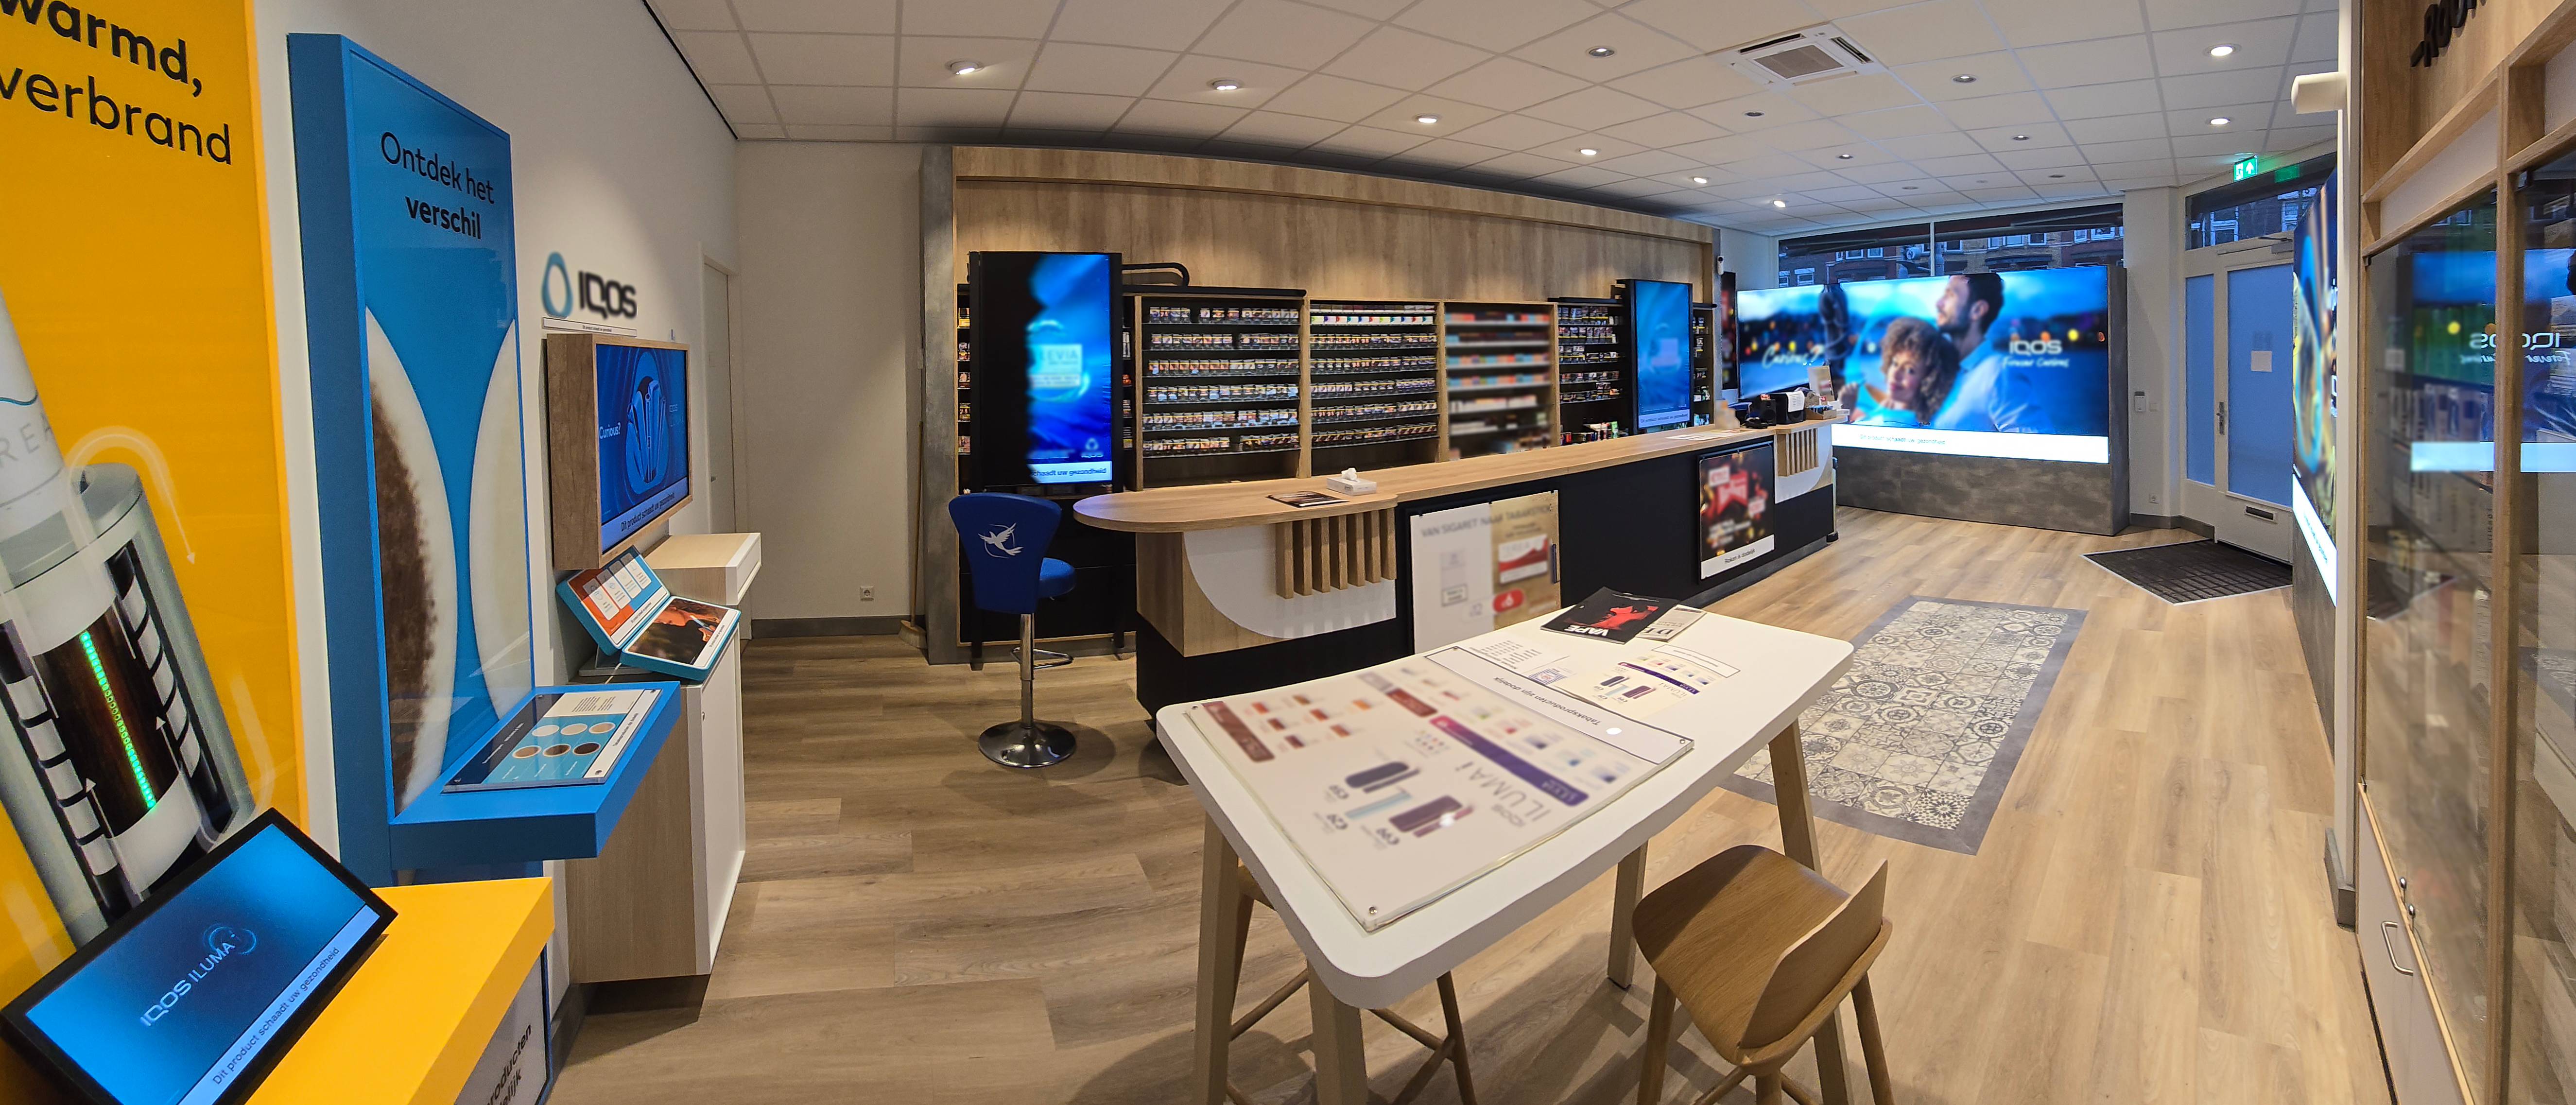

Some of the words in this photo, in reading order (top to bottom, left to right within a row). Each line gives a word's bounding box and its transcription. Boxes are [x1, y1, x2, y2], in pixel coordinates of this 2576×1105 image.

[0, 68, 231, 165] verbrand
[381, 132, 462, 192] Ontdek
[466, 167, 495, 205] het
[405, 195, 482, 240] verschil
[578, 271, 637, 319] IQOS
[2009, 340, 2063, 357] IQOS
[599, 422, 621, 439] Curious?
[1566, 625, 1609, 637] VAPE
[1494, 676, 1521, 691] dodelijk
[1521, 688, 1536, 696] zijn
[1535, 693, 1602, 726] Tabaksproducten
[140, 979, 191, 1027] IQOS
[188, 942, 236, 983] ILUMA
[213, 1069, 228, 1085] Dit
[227, 1035, 260, 1071] product
[259, 1001, 290, 1036] schaadt
[288, 989, 301, 1003] uw
[300, 947, 340, 991] gezondheid
[487, 1024, 531, 1105] roducten
[500, 1068, 521, 1105] elijk
